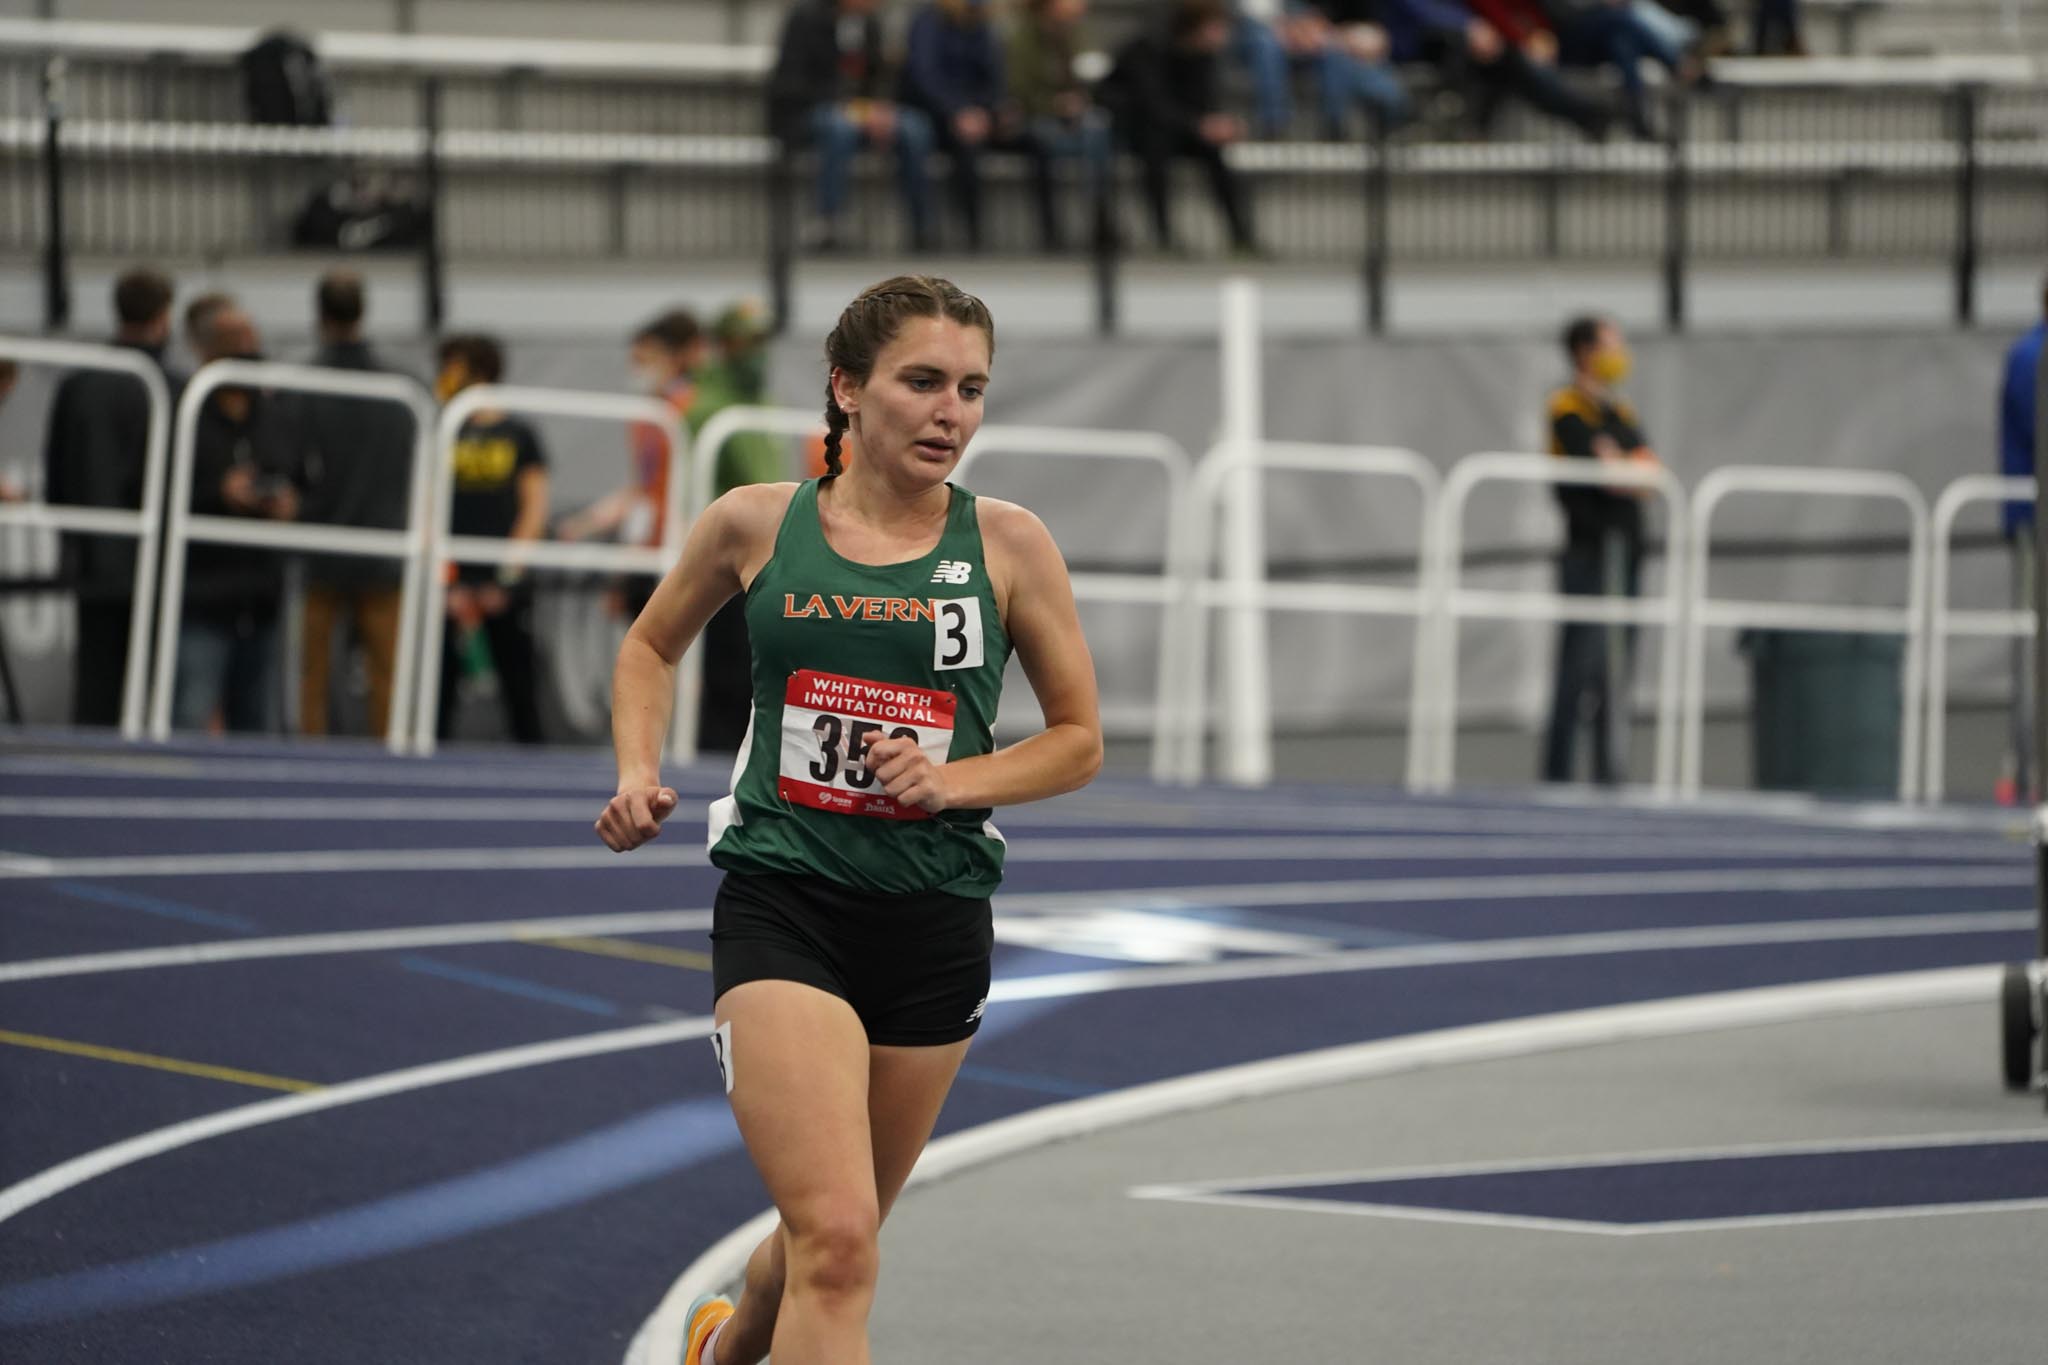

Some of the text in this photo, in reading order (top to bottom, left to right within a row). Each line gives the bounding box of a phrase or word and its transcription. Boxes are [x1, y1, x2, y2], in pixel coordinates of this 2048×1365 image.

[784, 593, 936, 622] LA VERN
[941, 602, 968, 666] 3
[804, 691, 936, 723] INVITATIONAL
[812, 678, 932, 707] WHITWORTH
[809, 714, 919, 789] 35
